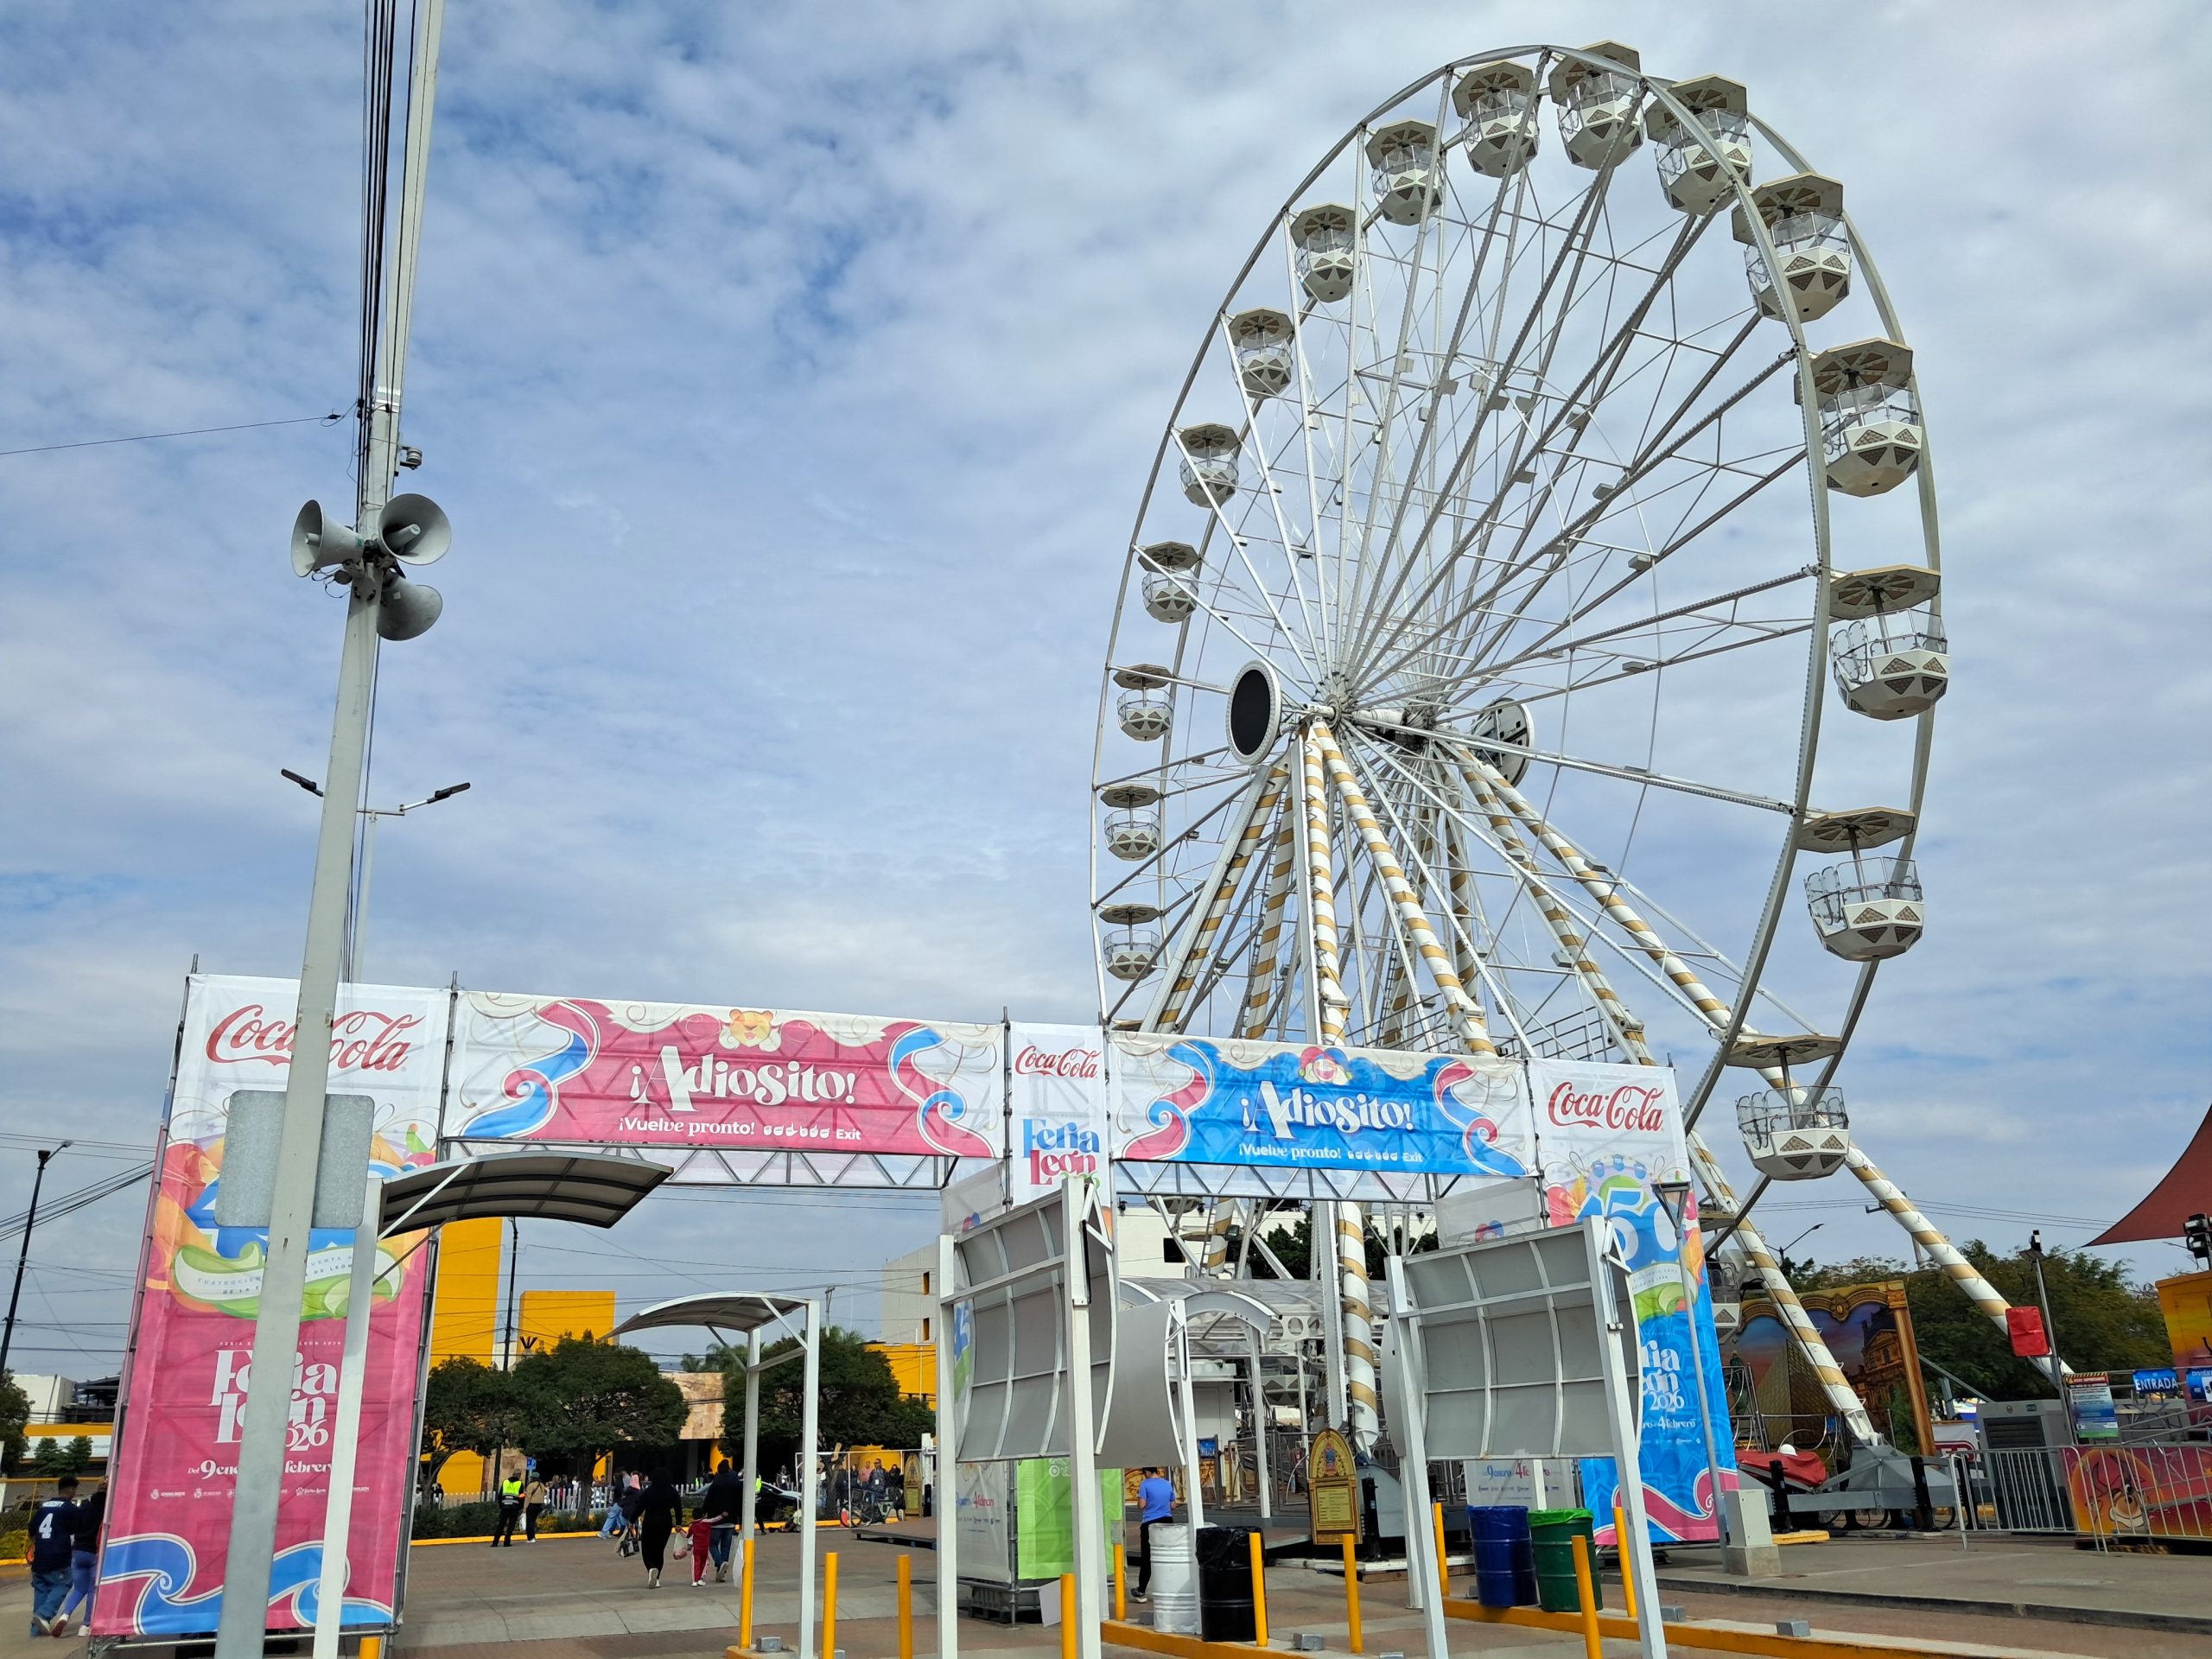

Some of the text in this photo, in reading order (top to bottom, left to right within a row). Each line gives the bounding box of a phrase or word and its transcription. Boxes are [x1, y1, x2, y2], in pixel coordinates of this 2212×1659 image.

[1014, 1045, 1103, 1079] Coca-Cola
[1548, 1081, 1665, 1132] Coca-Cola
[619, 1116, 861, 1141] ¡Vuelve pronto! Exit
[1022, 1118, 1101, 1159] Feria
[1239, 1143, 1424, 1163] ¡Vuelve pronto! Exit
[1029, 1149, 1097, 1185] León
[2134, 1377, 2179, 1391] ENTRADA
[1649, 1389, 1685, 1413] 2026
[39, 1512, 54, 1539] 4
